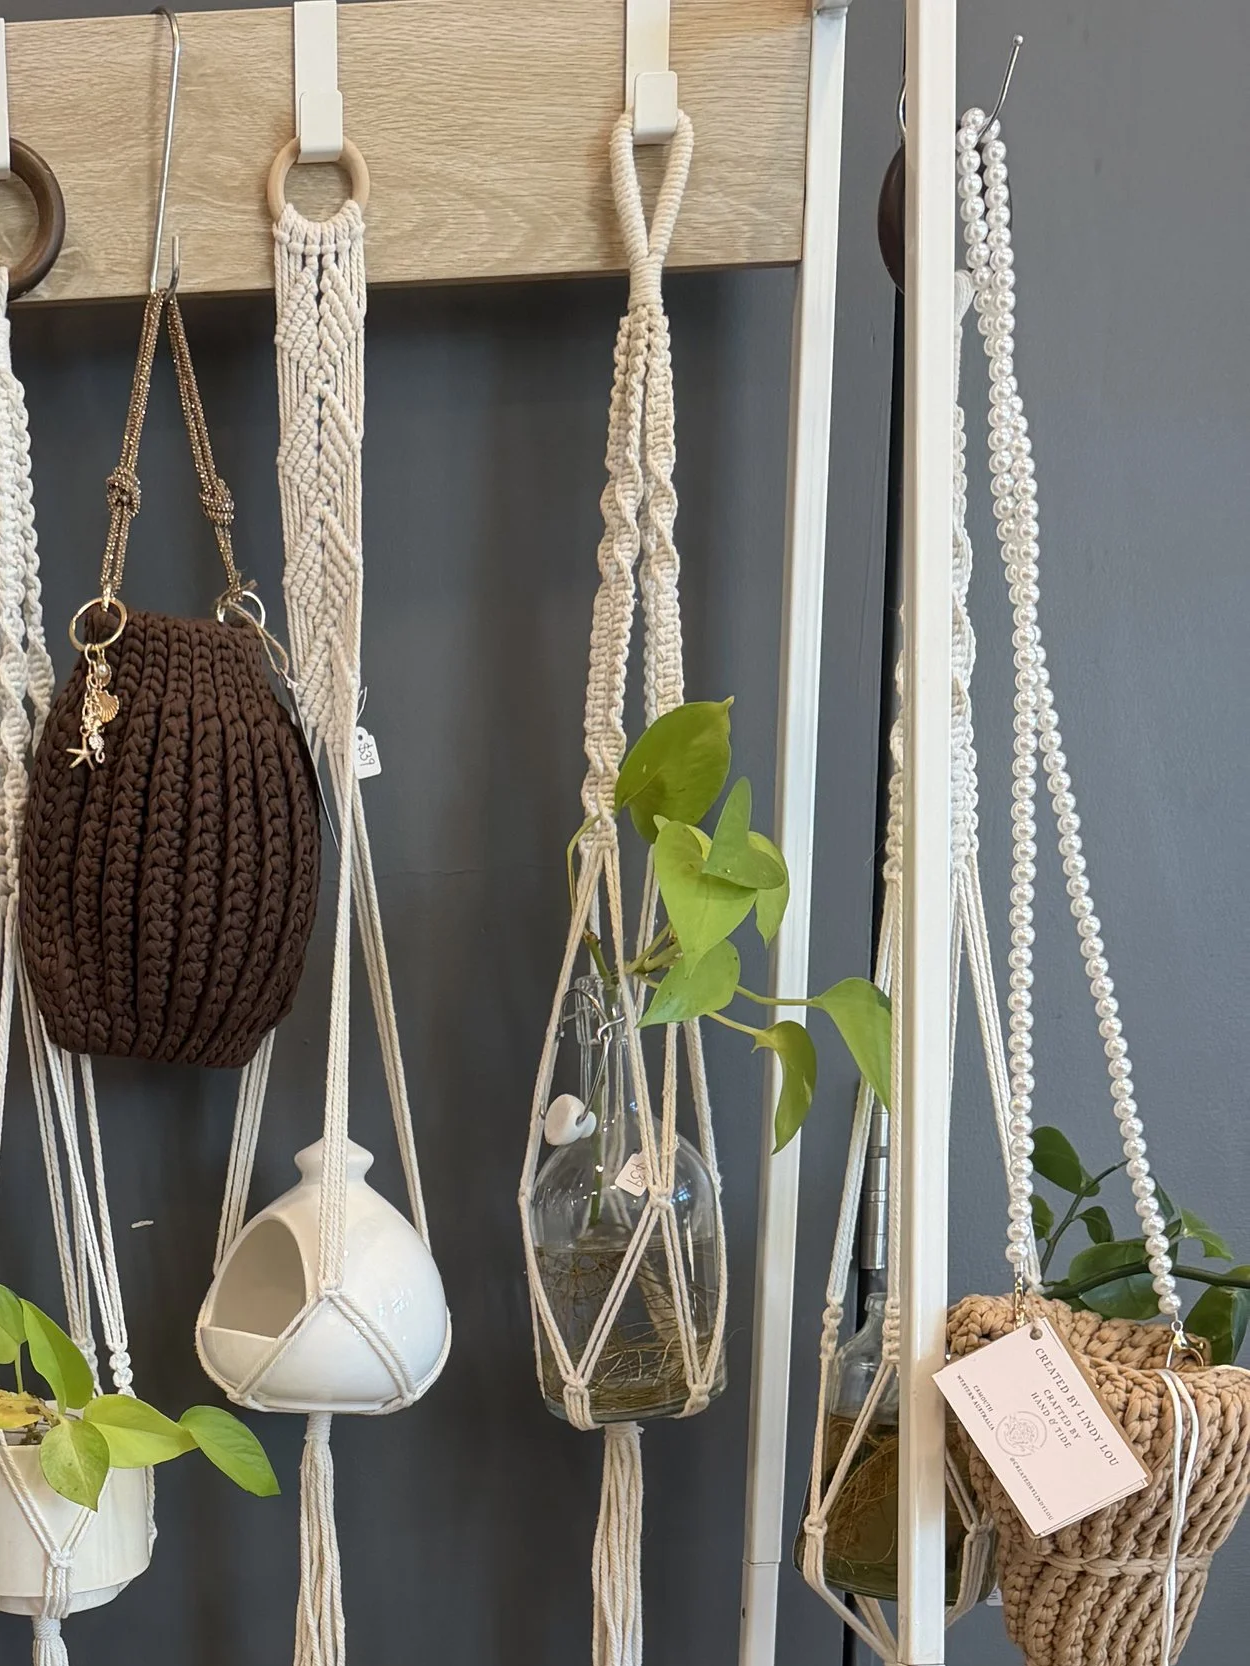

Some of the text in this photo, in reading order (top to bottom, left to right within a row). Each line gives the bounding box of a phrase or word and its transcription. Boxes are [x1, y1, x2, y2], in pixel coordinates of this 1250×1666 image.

[357, 742, 376, 767] $39
[1030, 1392, 1051, 1417] HAND
[1054, 1426, 1072, 1449] TIDE
[1035, 1348, 1119, 1466] CREATED BY LINDY LOU
[1043, 1389, 1081, 1439] CRAFTED BY
